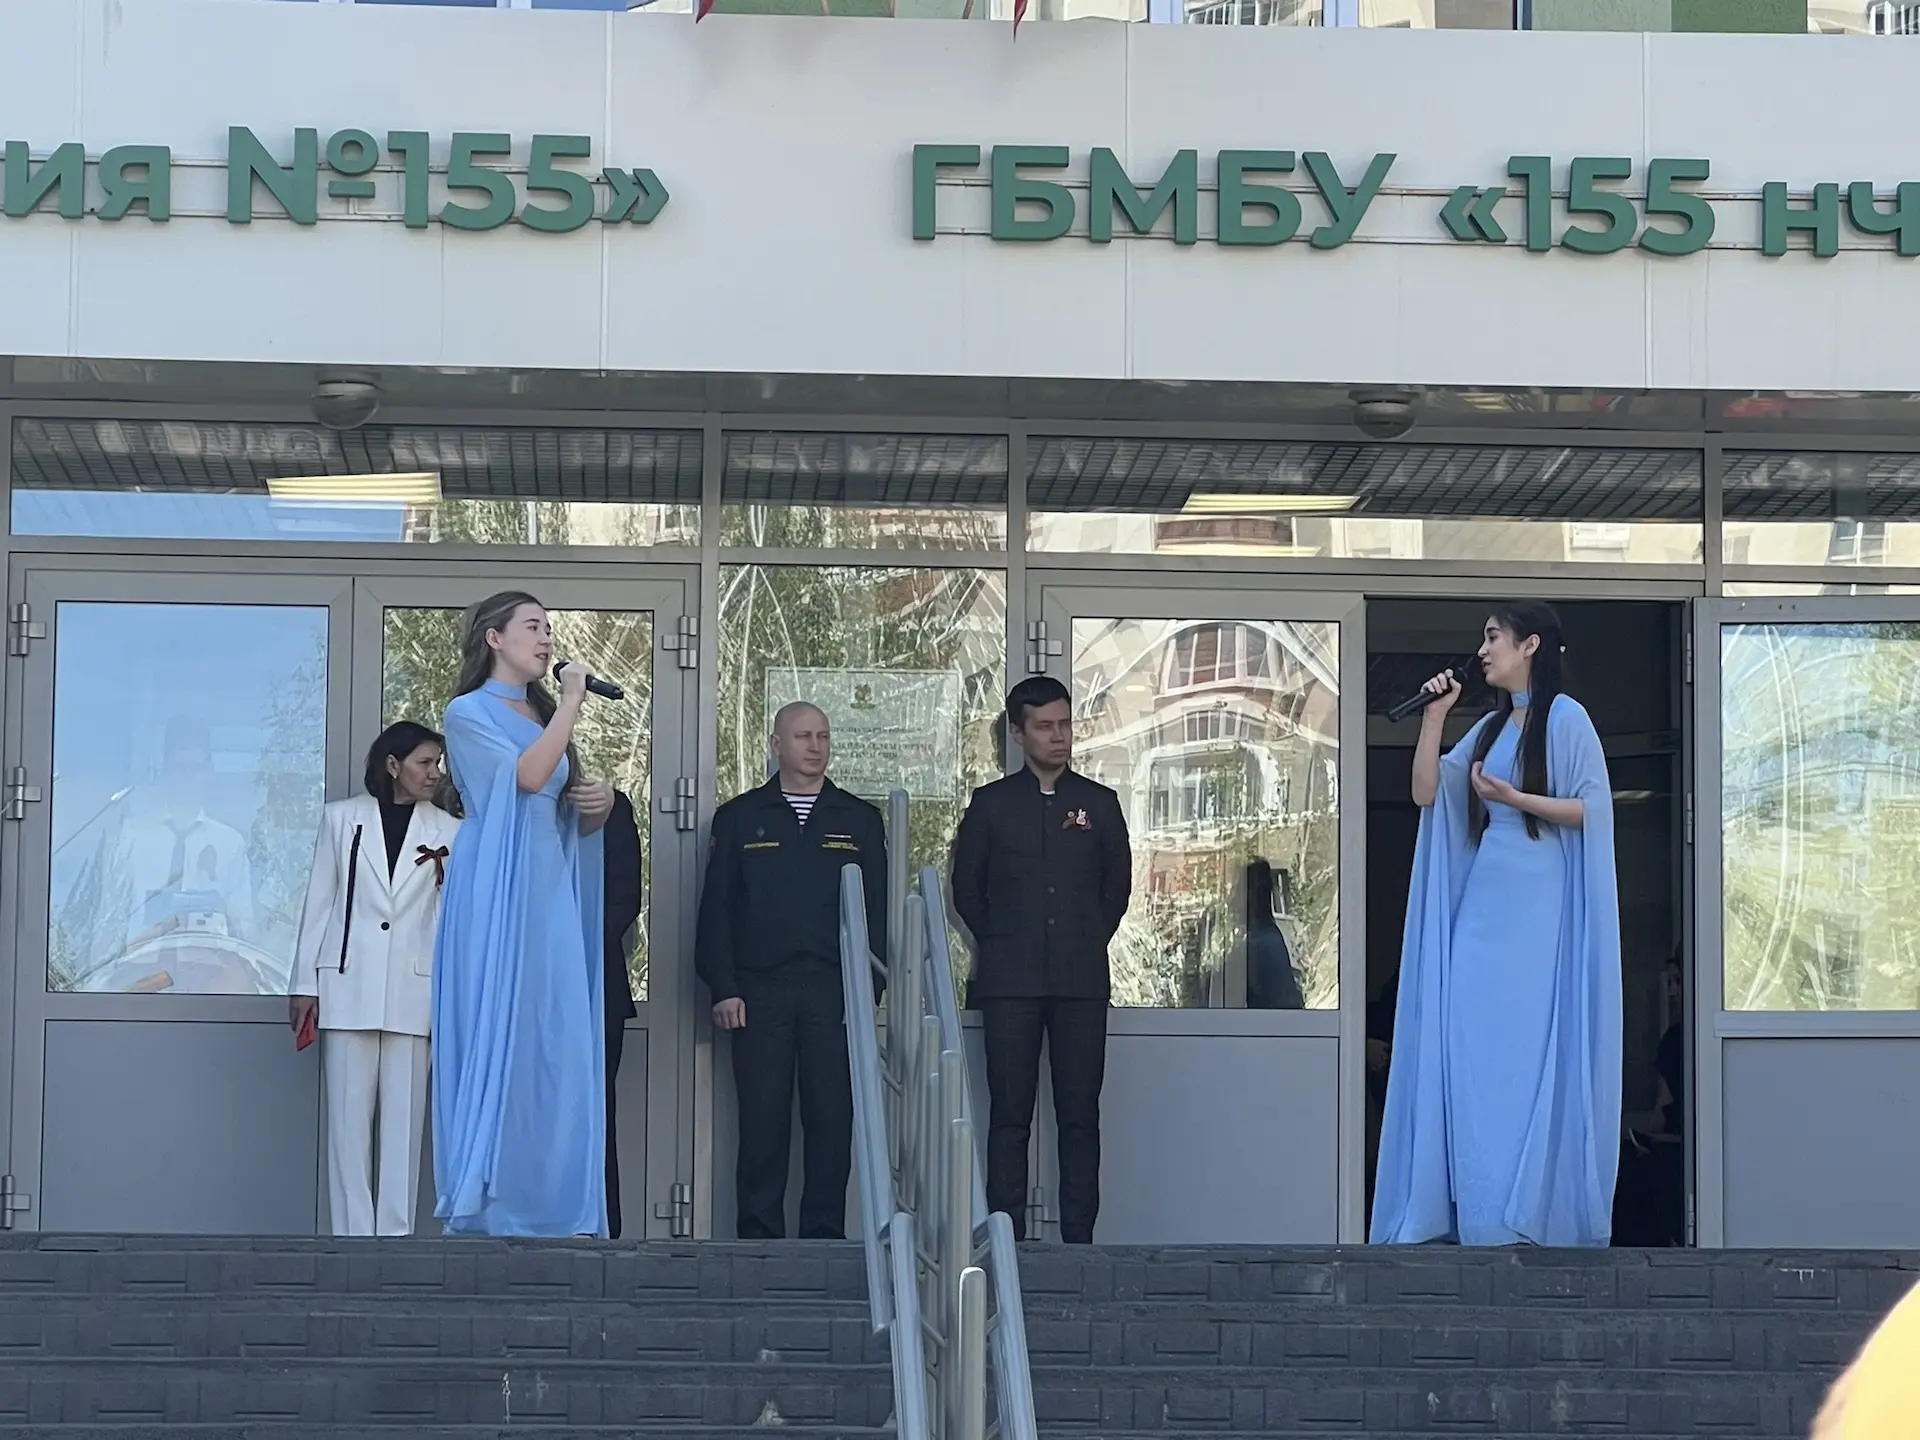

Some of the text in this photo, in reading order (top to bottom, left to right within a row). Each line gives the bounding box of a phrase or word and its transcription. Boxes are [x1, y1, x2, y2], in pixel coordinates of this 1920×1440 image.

[2, 140, 170, 219] ия
[913, 145, 1397, 250] ГБМБУ
[1439, 156, 1715, 256] «155
